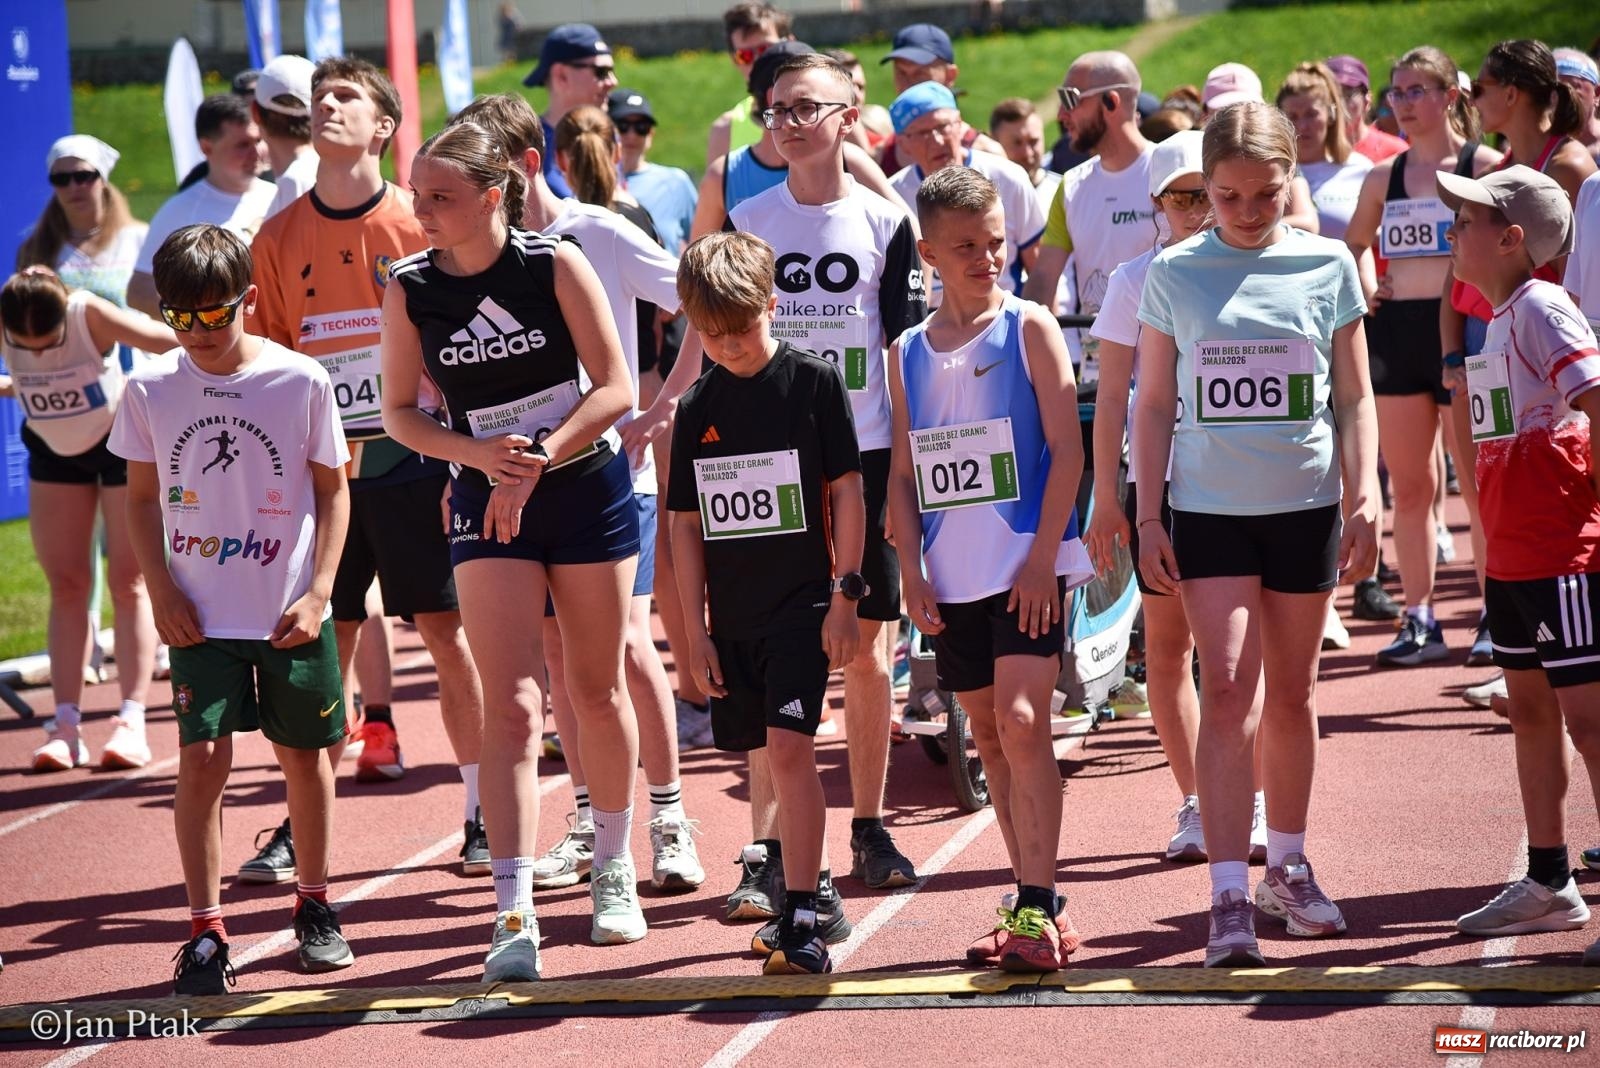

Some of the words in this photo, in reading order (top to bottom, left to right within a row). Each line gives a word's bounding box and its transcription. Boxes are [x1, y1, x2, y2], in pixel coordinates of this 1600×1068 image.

[1389, 224, 1433, 247] 038
[774, 252, 860, 293] GO
[770, 321, 786, 329] XVIII
[787, 321, 803, 329] BIEG
[805, 321, 818, 329] BEZ
[819, 321, 846, 329] GRANIC
[770, 330, 809, 338] 3MAJA2026
[439, 329, 547, 366] adidas
[1201, 347, 1220, 356] XVIII
[1222, 346, 1240, 355] BIEG
[1242, 345, 1256, 355] BEZ
[1258, 345, 1288, 354] GRANIC
[335, 356, 347, 365] BEZ
[348, 351, 373, 362] GRANIC
[1201, 356, 1246, 365] 3MAJA2026
[31, 390, 84, 412] 062
[1208, 376, 1282, 409] 006
[476, 414, 493, 423] XVIII
[494, 409, 512, 420] BIEG
[512, 404, 527, 416] BEZ
[527, 394, 555, 410] GRANIC
[479, 416, 520, 432] 3MAJA2026
[916, 434, 931, 444] XVIII
[931, 432, 945, 442] BIEG
[946, 429, 958, 439] BEZ
[960, 426, 988, 438] GRANIC
[170, 415, 227, 475] INTERNATIONAL
[232, 416, 283, 477] TOURNAMENT
[917, 441, 951, 454] 3MAJA2026
[701, 464, 716, 473] XVIII
[717, 462, 732, 471] BIEG
[733, 460, 746, 470] BEZ
[747, 458, 774, 469] GRANIC
[702, 471, 738, 482] 3MAJA2026
[932, 459, 982, 494] 012
[710, 489, 773, 523] 008
[173, 528, 281, 567] trophy
